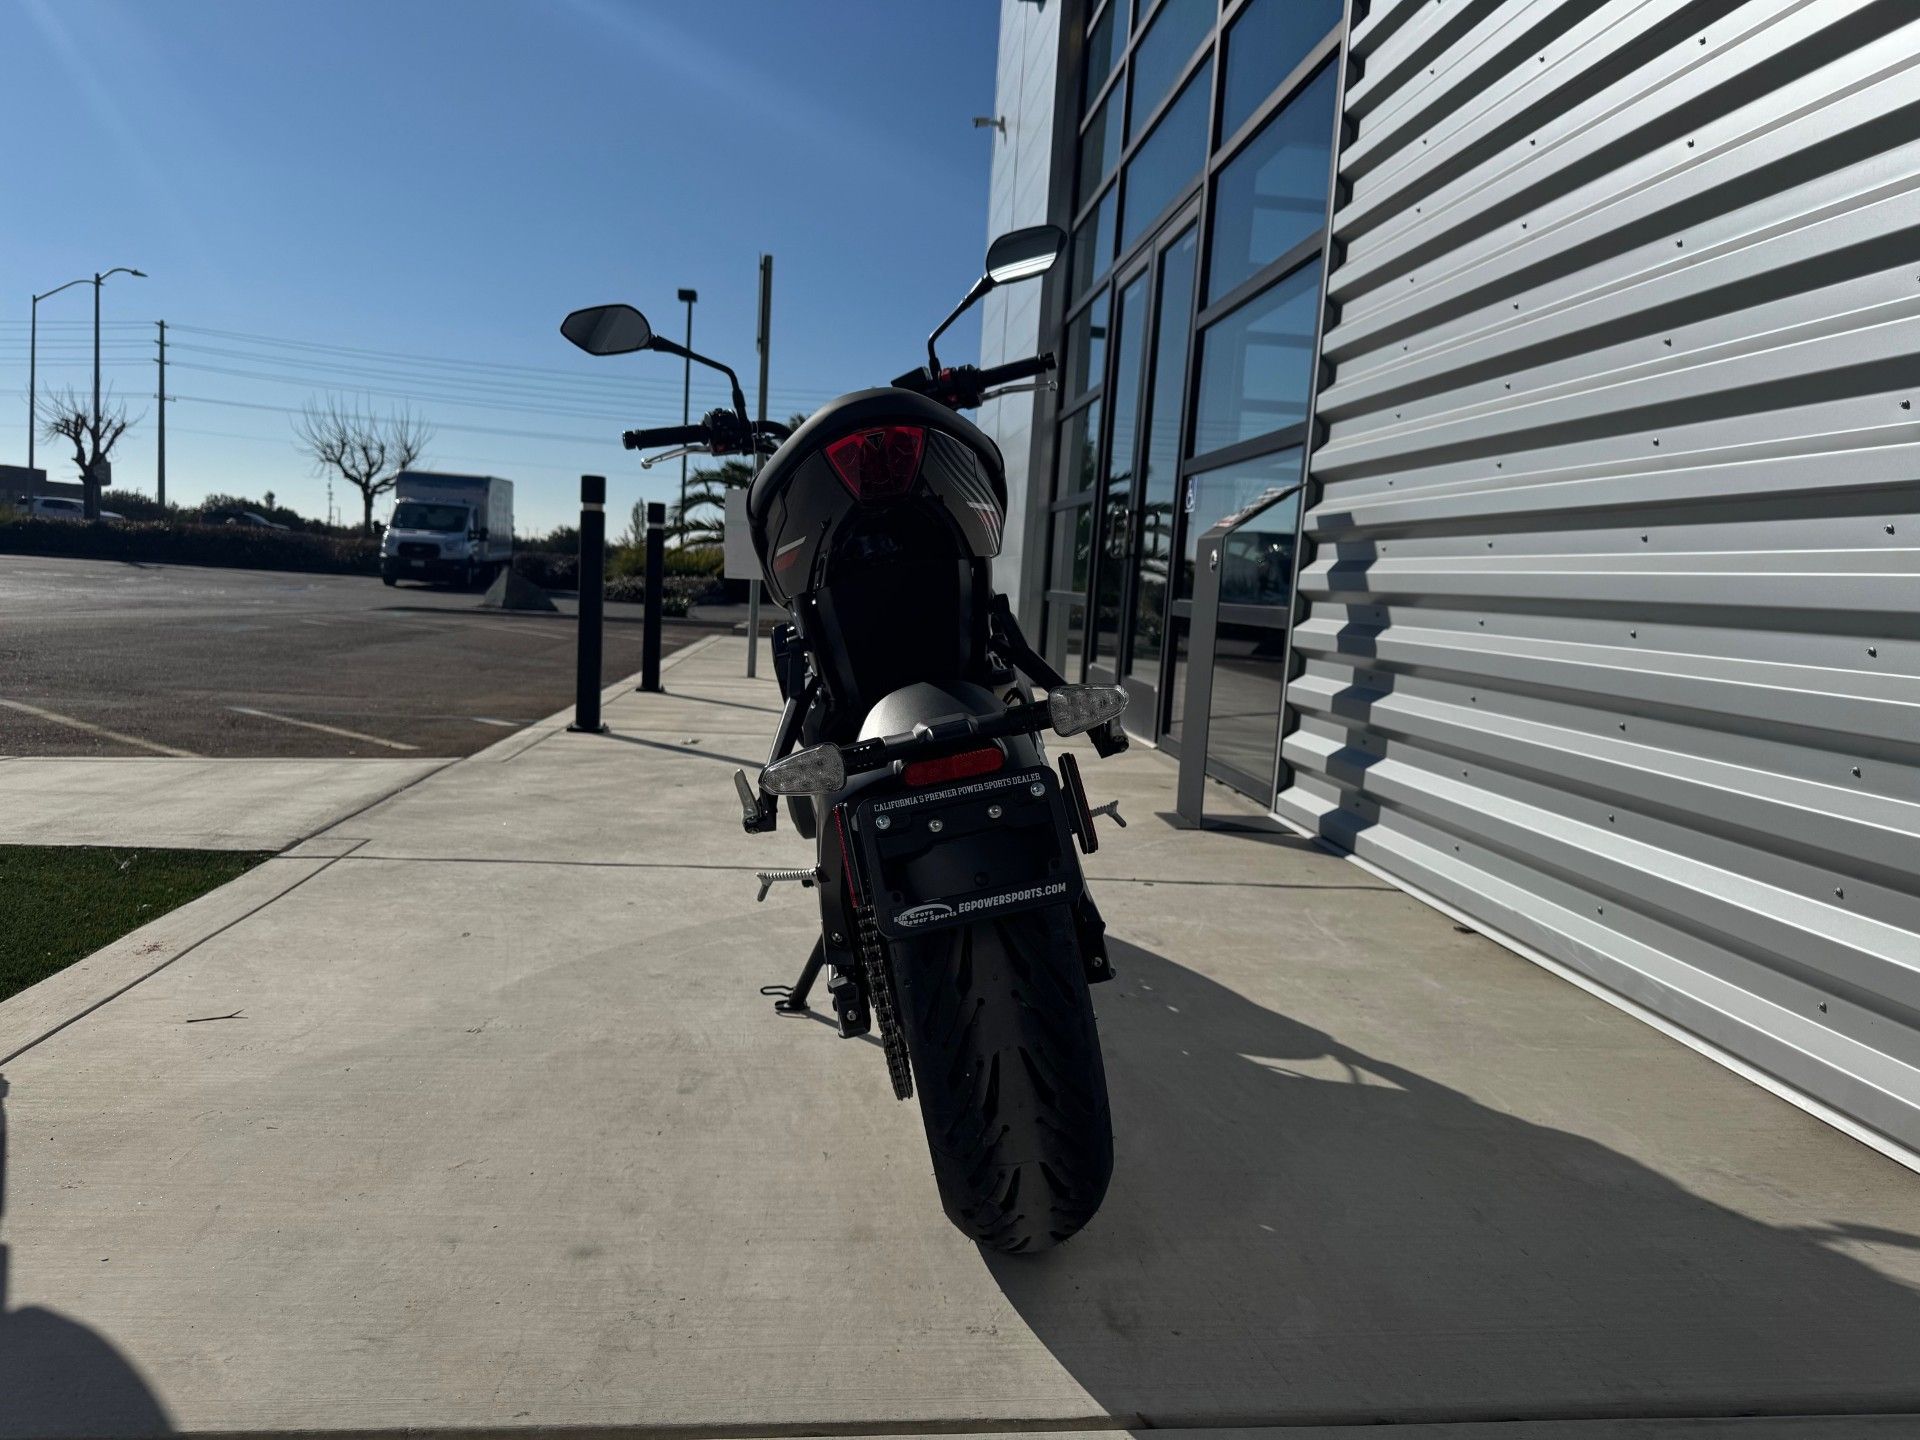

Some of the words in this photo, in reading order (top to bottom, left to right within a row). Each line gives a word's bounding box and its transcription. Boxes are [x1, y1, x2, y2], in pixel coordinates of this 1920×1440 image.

[874, 795, 925, 812] CALIFORNIA'S
[925, 787, 958, 802] PREMIER
[957, 783, 984, 796] POWER
[984, 777, 1012, 790] SPORTS
[1012, 772, 1041, 785] DEALER
[958, 881, 1067, 914] EGPOWERSPORTS.COM
